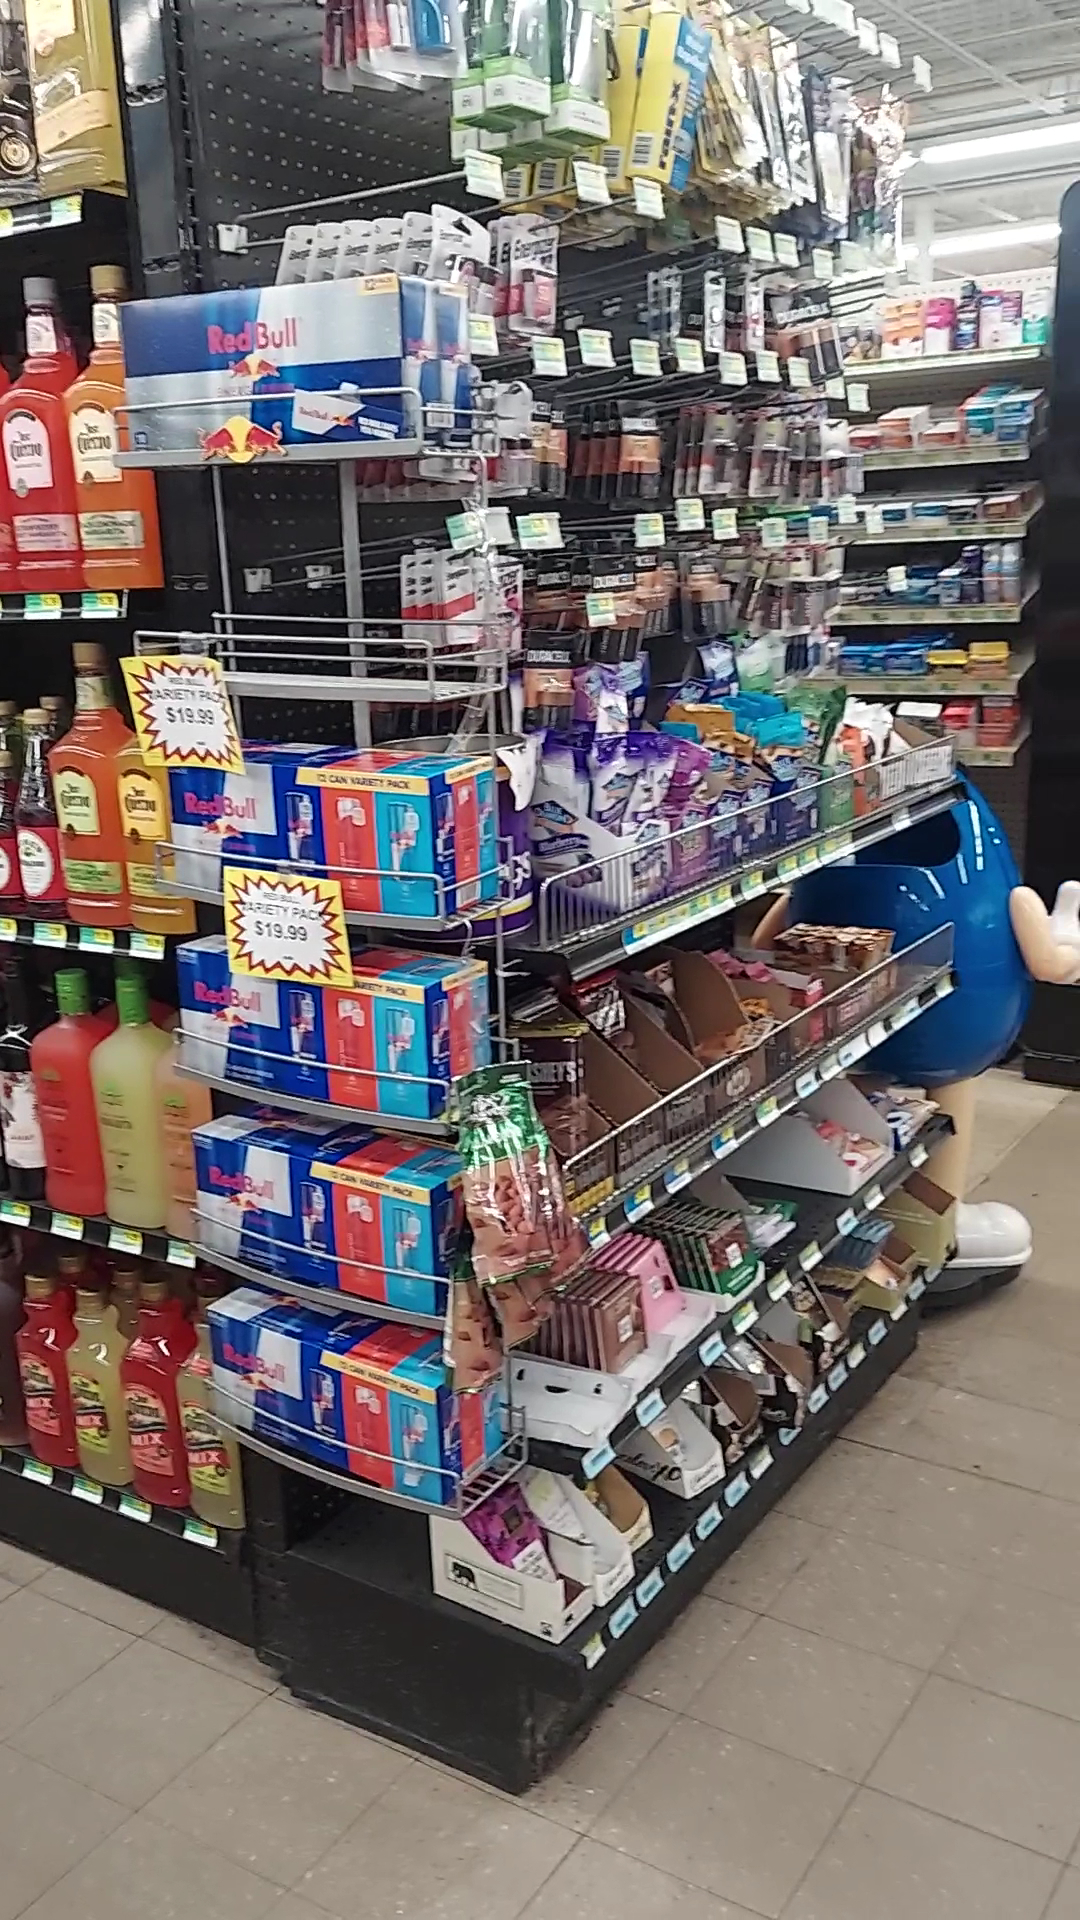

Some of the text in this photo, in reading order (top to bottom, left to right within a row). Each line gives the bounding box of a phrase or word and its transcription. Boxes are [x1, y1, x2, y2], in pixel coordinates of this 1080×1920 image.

[207, 317, 298, 355] Red Bull
[166, 706, 215, 726] $19.99
[183, 791, 257, 820] Red Bull
[254, 920, 308, 942] $19.99
